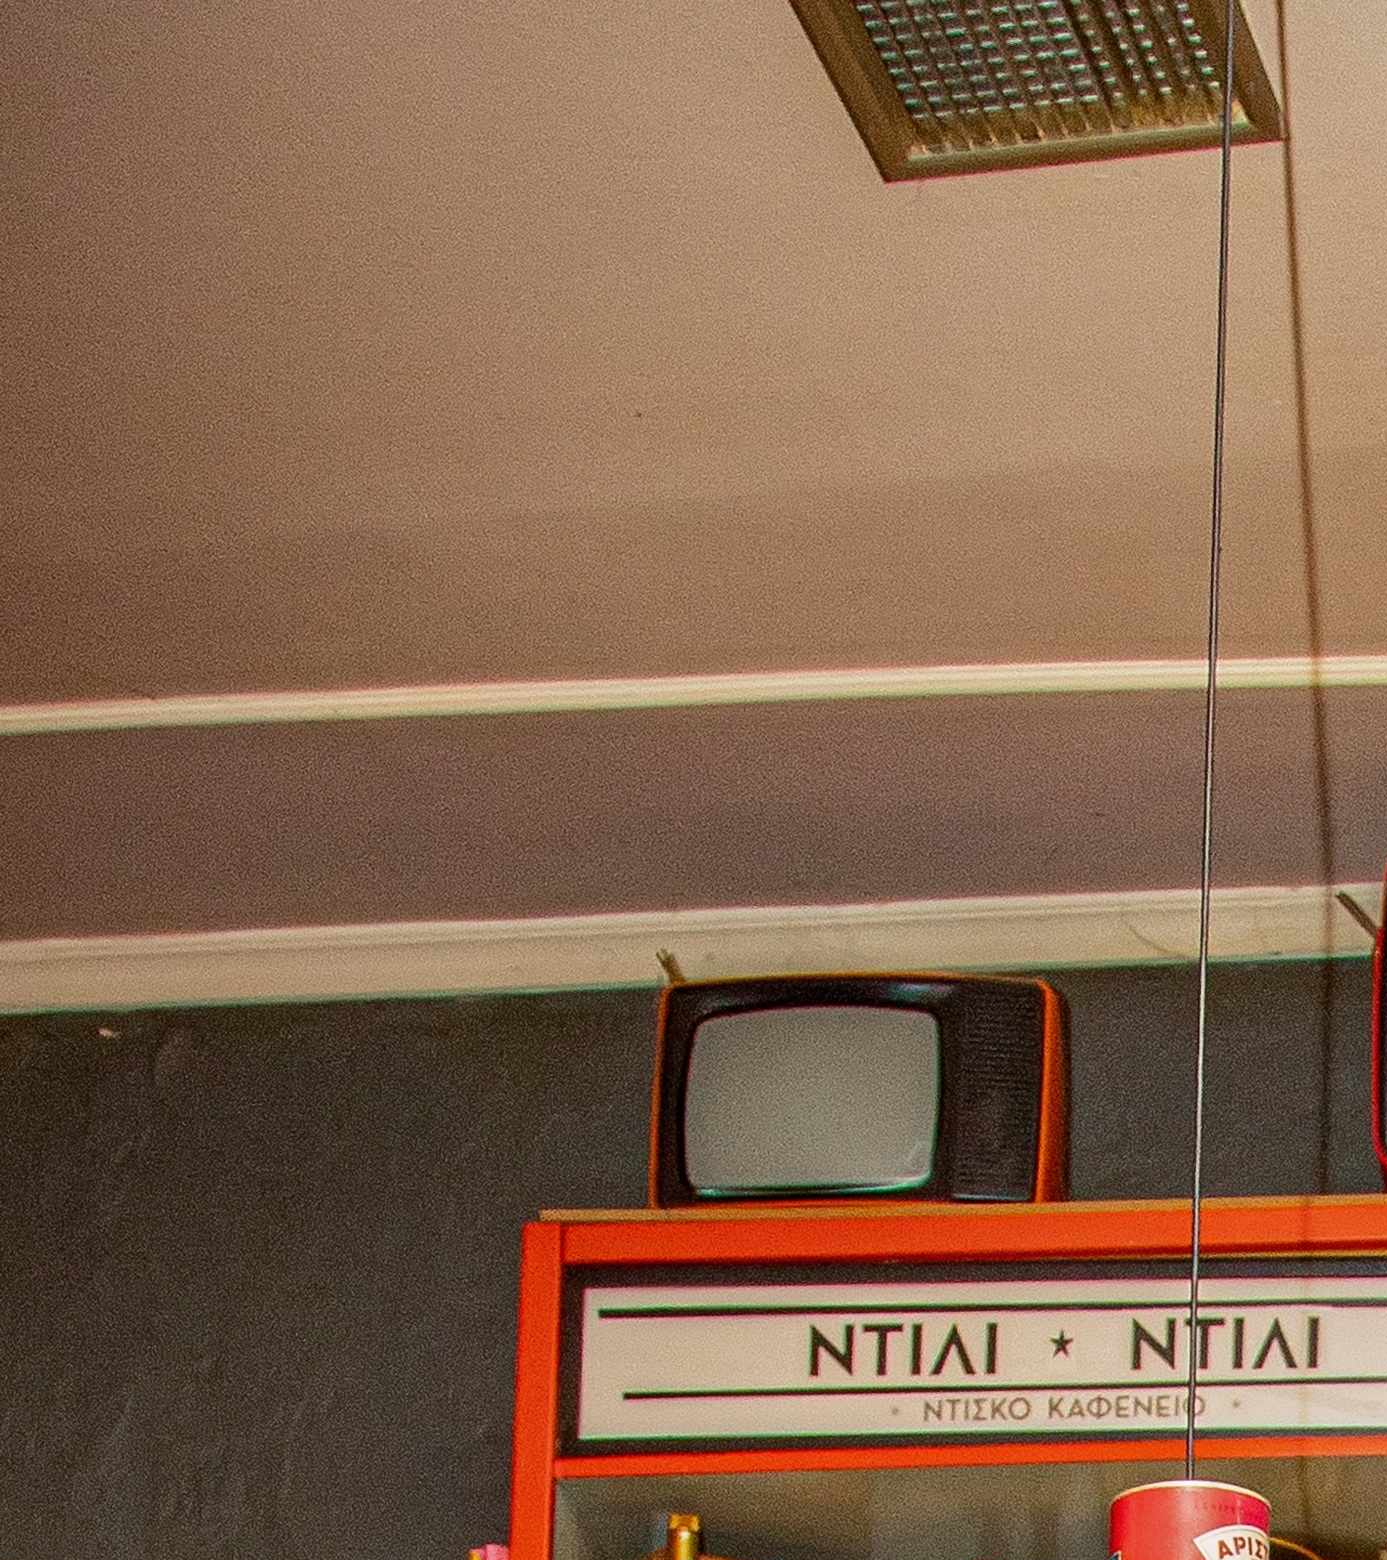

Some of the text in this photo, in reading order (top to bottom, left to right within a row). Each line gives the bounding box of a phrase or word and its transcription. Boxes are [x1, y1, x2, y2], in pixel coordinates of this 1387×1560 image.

[808, 1315, 1320, 1377] ΝΤΙΛΙ ΝΤΙΛΙ
[922, 1393, 1208, 1422] ΝΤΙΣΚΟ ΚΑΦΕΝΕΙΟ
